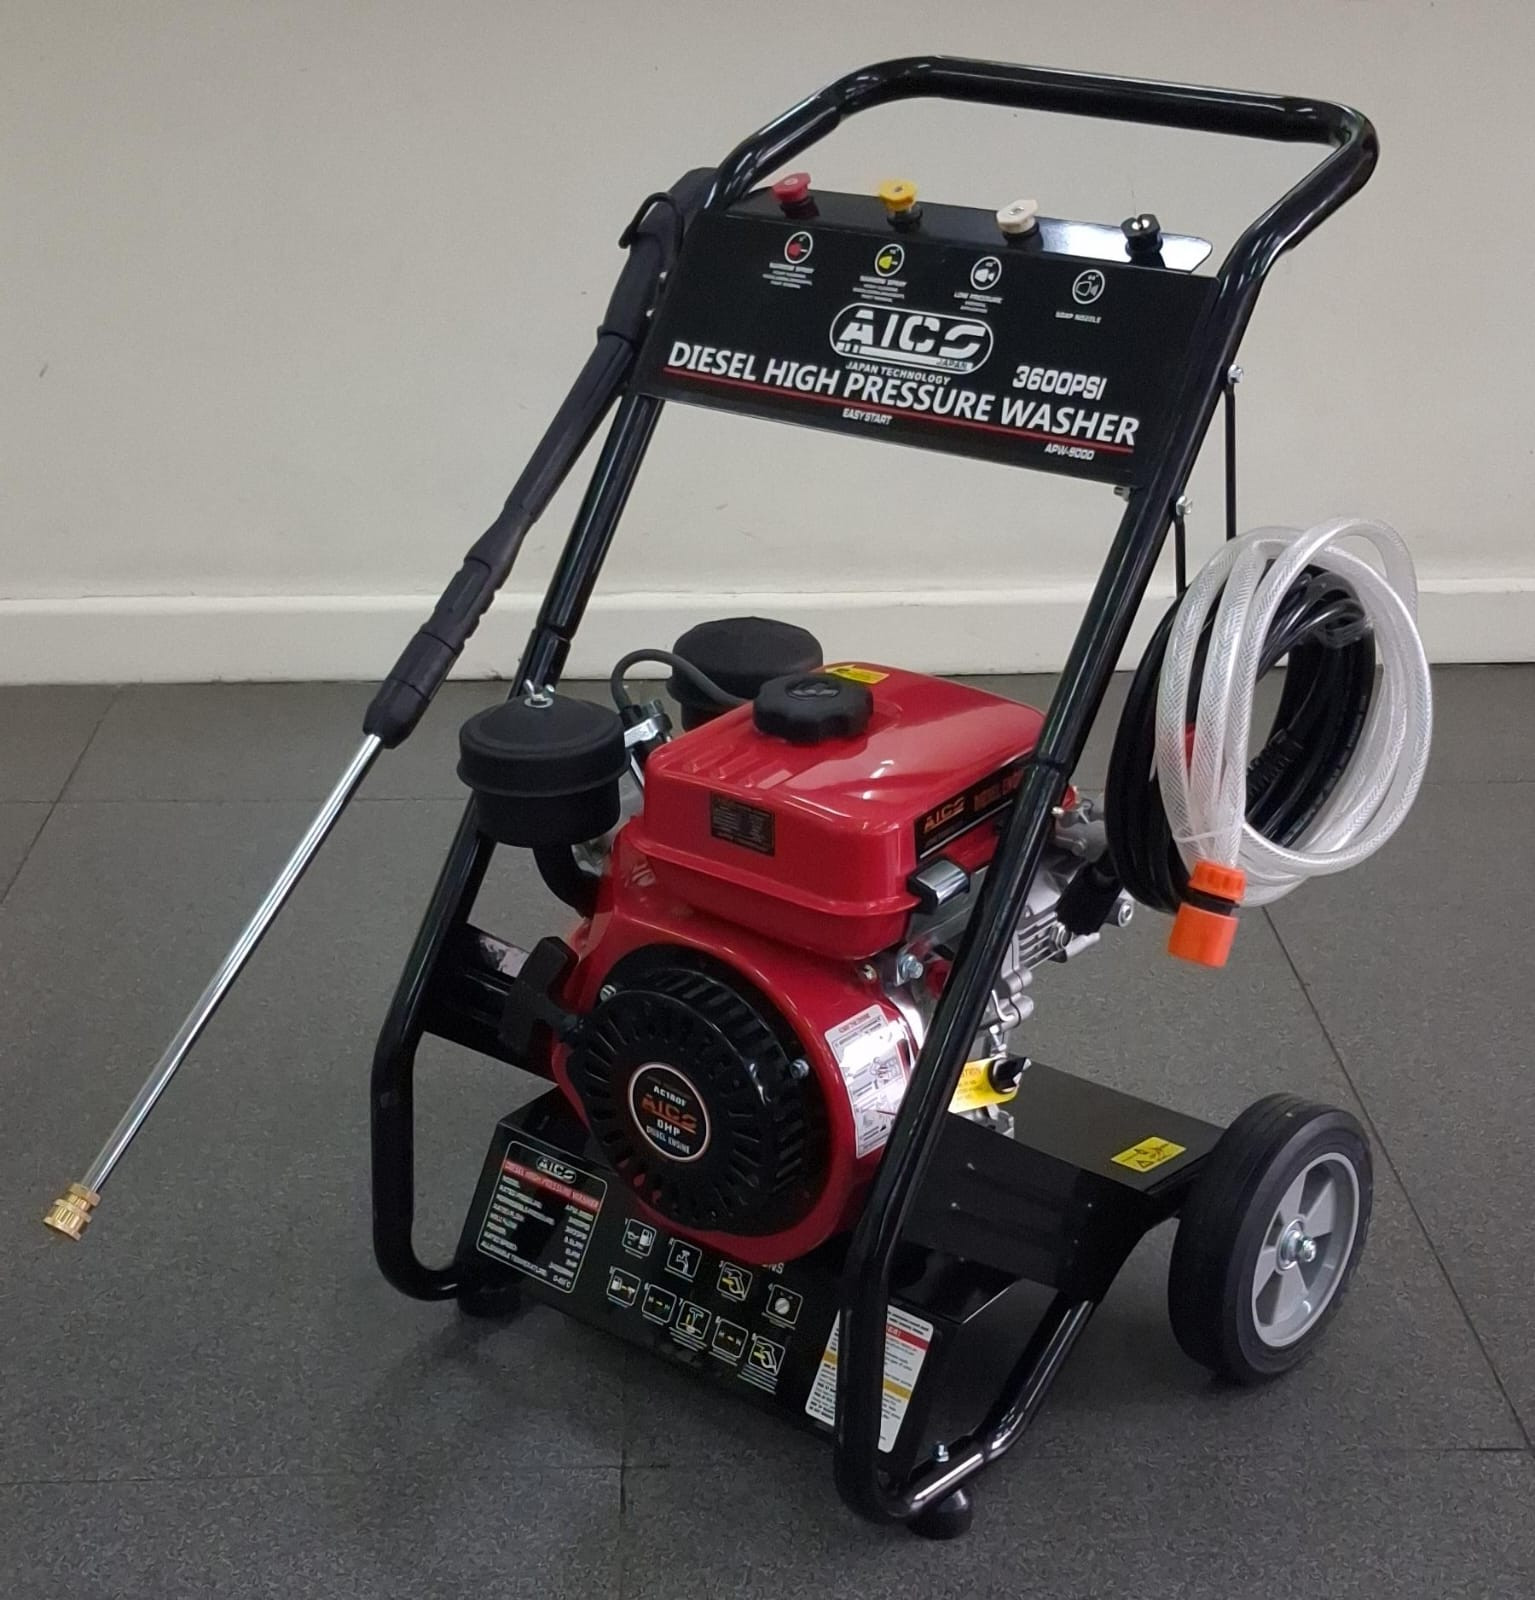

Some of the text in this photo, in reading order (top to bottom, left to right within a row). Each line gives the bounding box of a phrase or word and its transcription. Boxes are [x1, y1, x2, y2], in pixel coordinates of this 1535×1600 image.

[839, 309, 986, 359] AICS
[667, 341, 1140, 446] DIESEL HIGH PRESSURE WASHER
[845, 361, 951, 386] JAPAN TECHNOLOGY
[1012, 365, 1108, 401] 3600PSI
